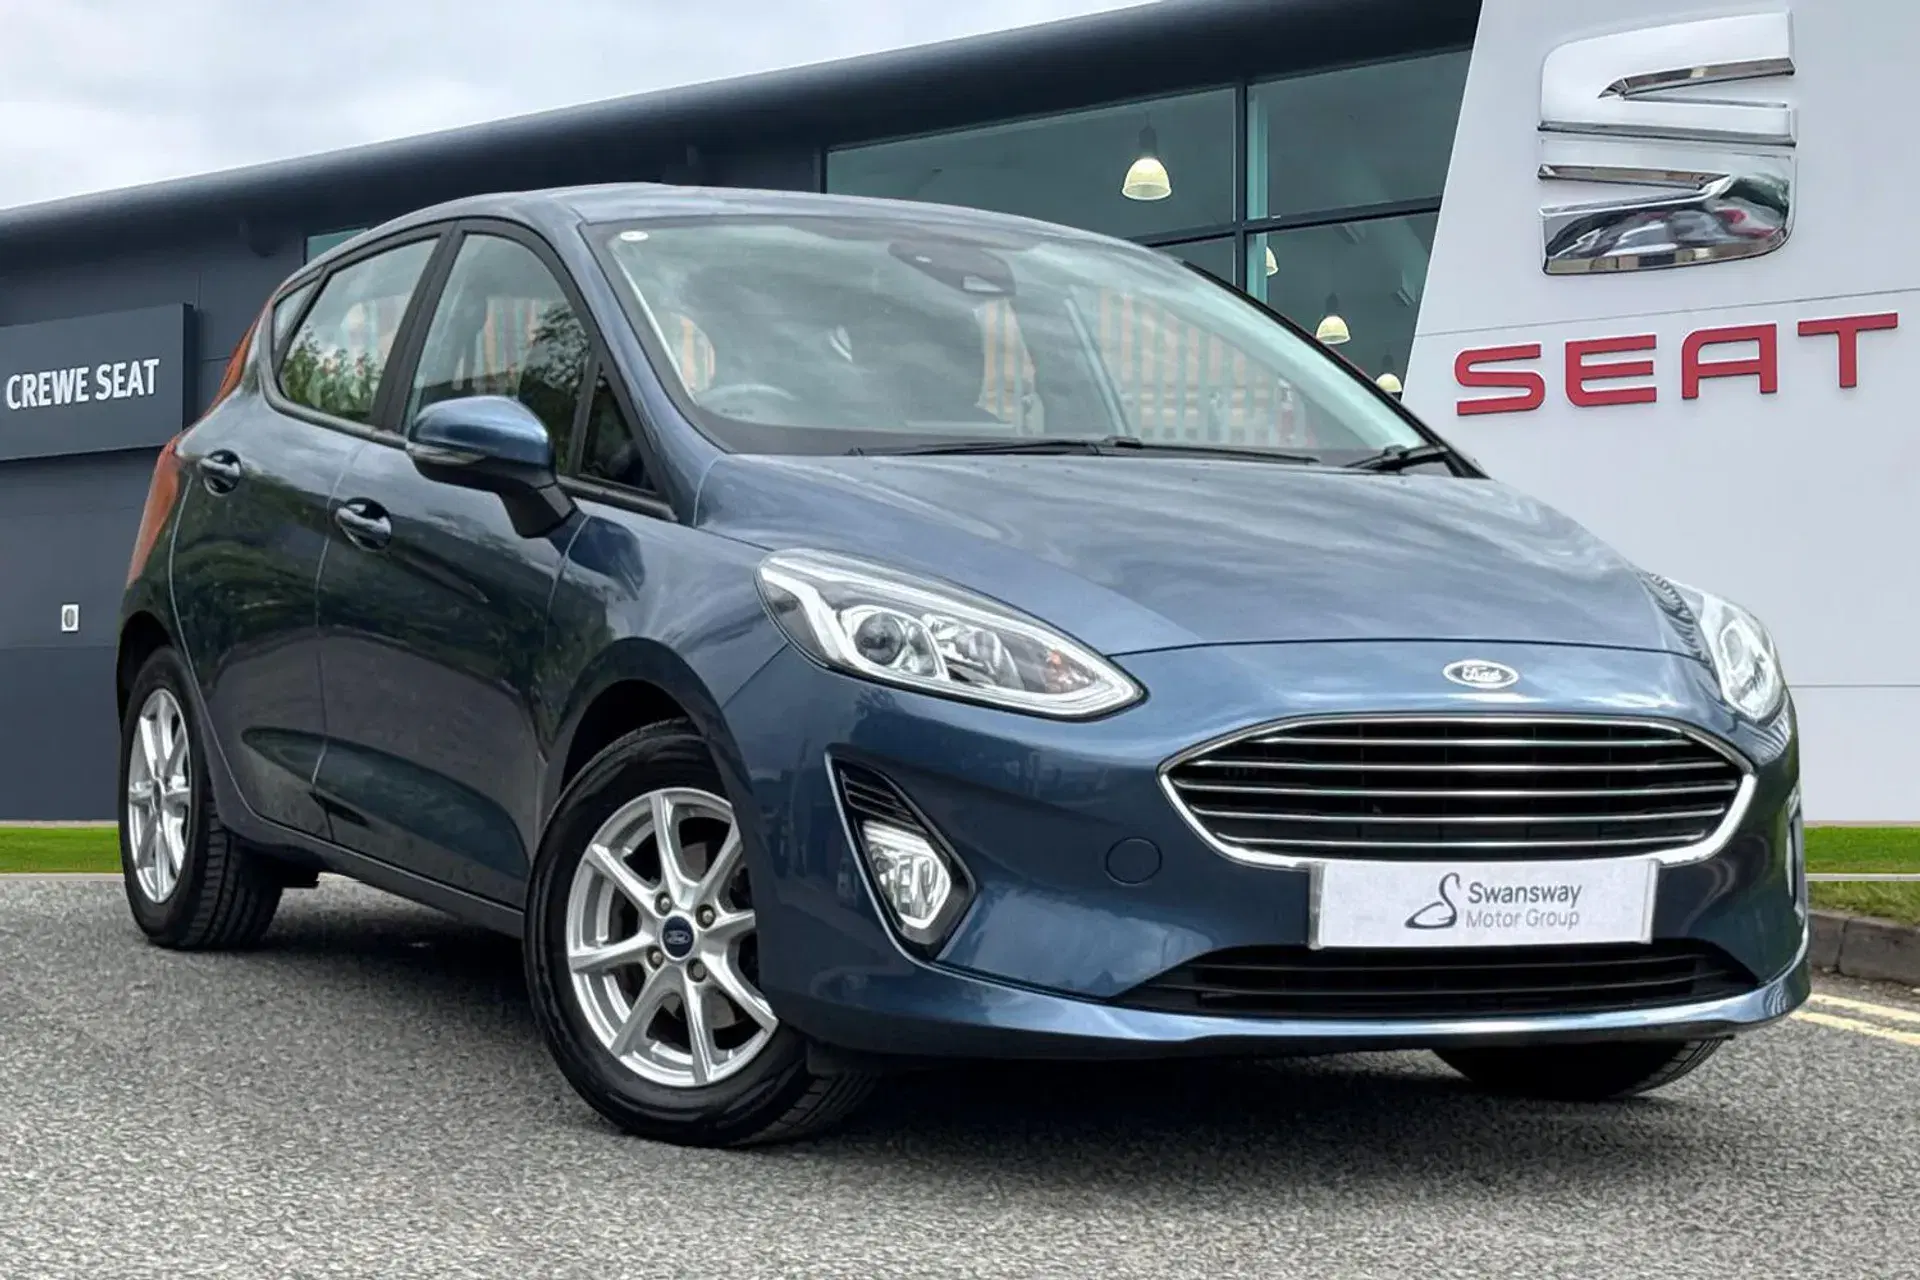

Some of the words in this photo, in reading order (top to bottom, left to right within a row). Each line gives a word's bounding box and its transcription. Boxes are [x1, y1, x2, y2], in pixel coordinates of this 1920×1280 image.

[1454, 312, 1899, 416] SEAT
[6, 366, 90, 410] CREWE
[95, 358, 160, 401] SEAT
[1467, 881, 1583, 908] Swansway
[1465, 908, 1520, 929] Motor
[1526, 908, 1580, 930] Group
